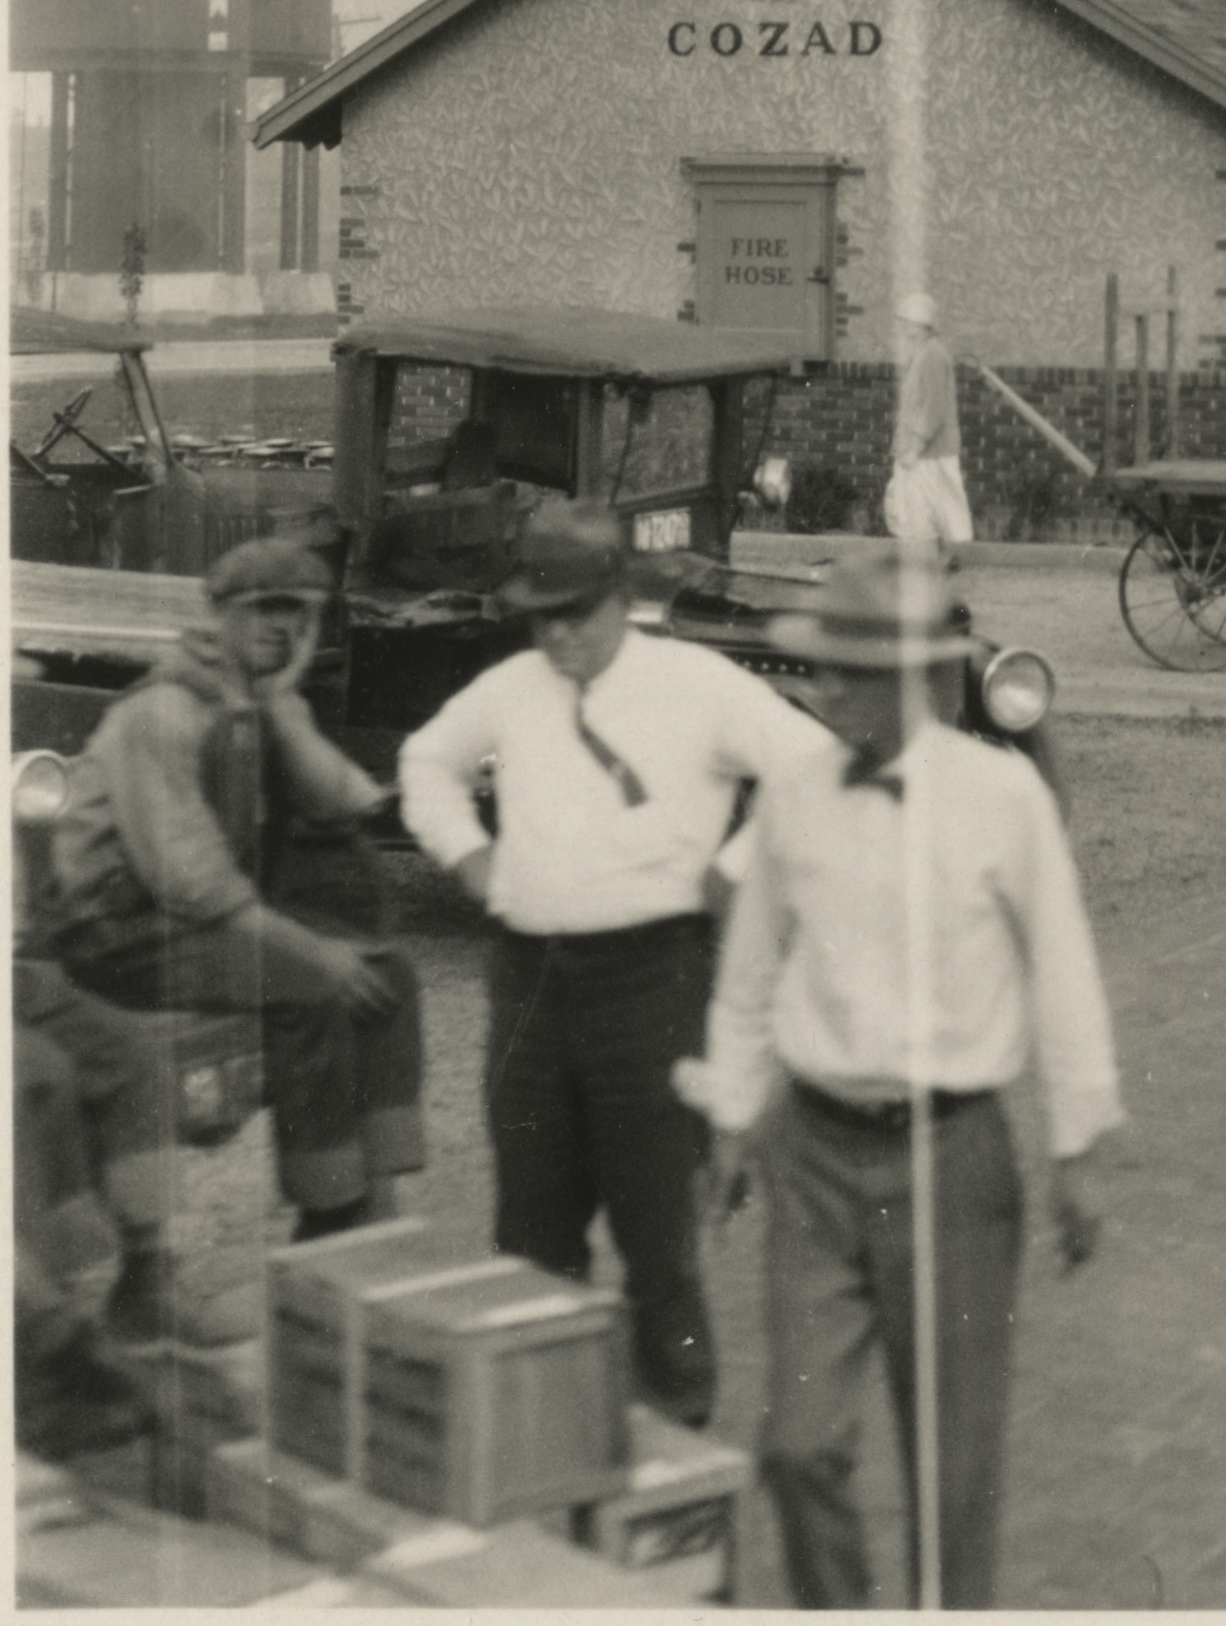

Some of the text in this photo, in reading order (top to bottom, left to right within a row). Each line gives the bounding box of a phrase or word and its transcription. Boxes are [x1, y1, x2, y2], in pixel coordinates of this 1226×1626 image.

[667, 21, 883, 57] COZAD
[730, 237, 789, 258] FIRE
[724, 266, 792, 286] HOSE
